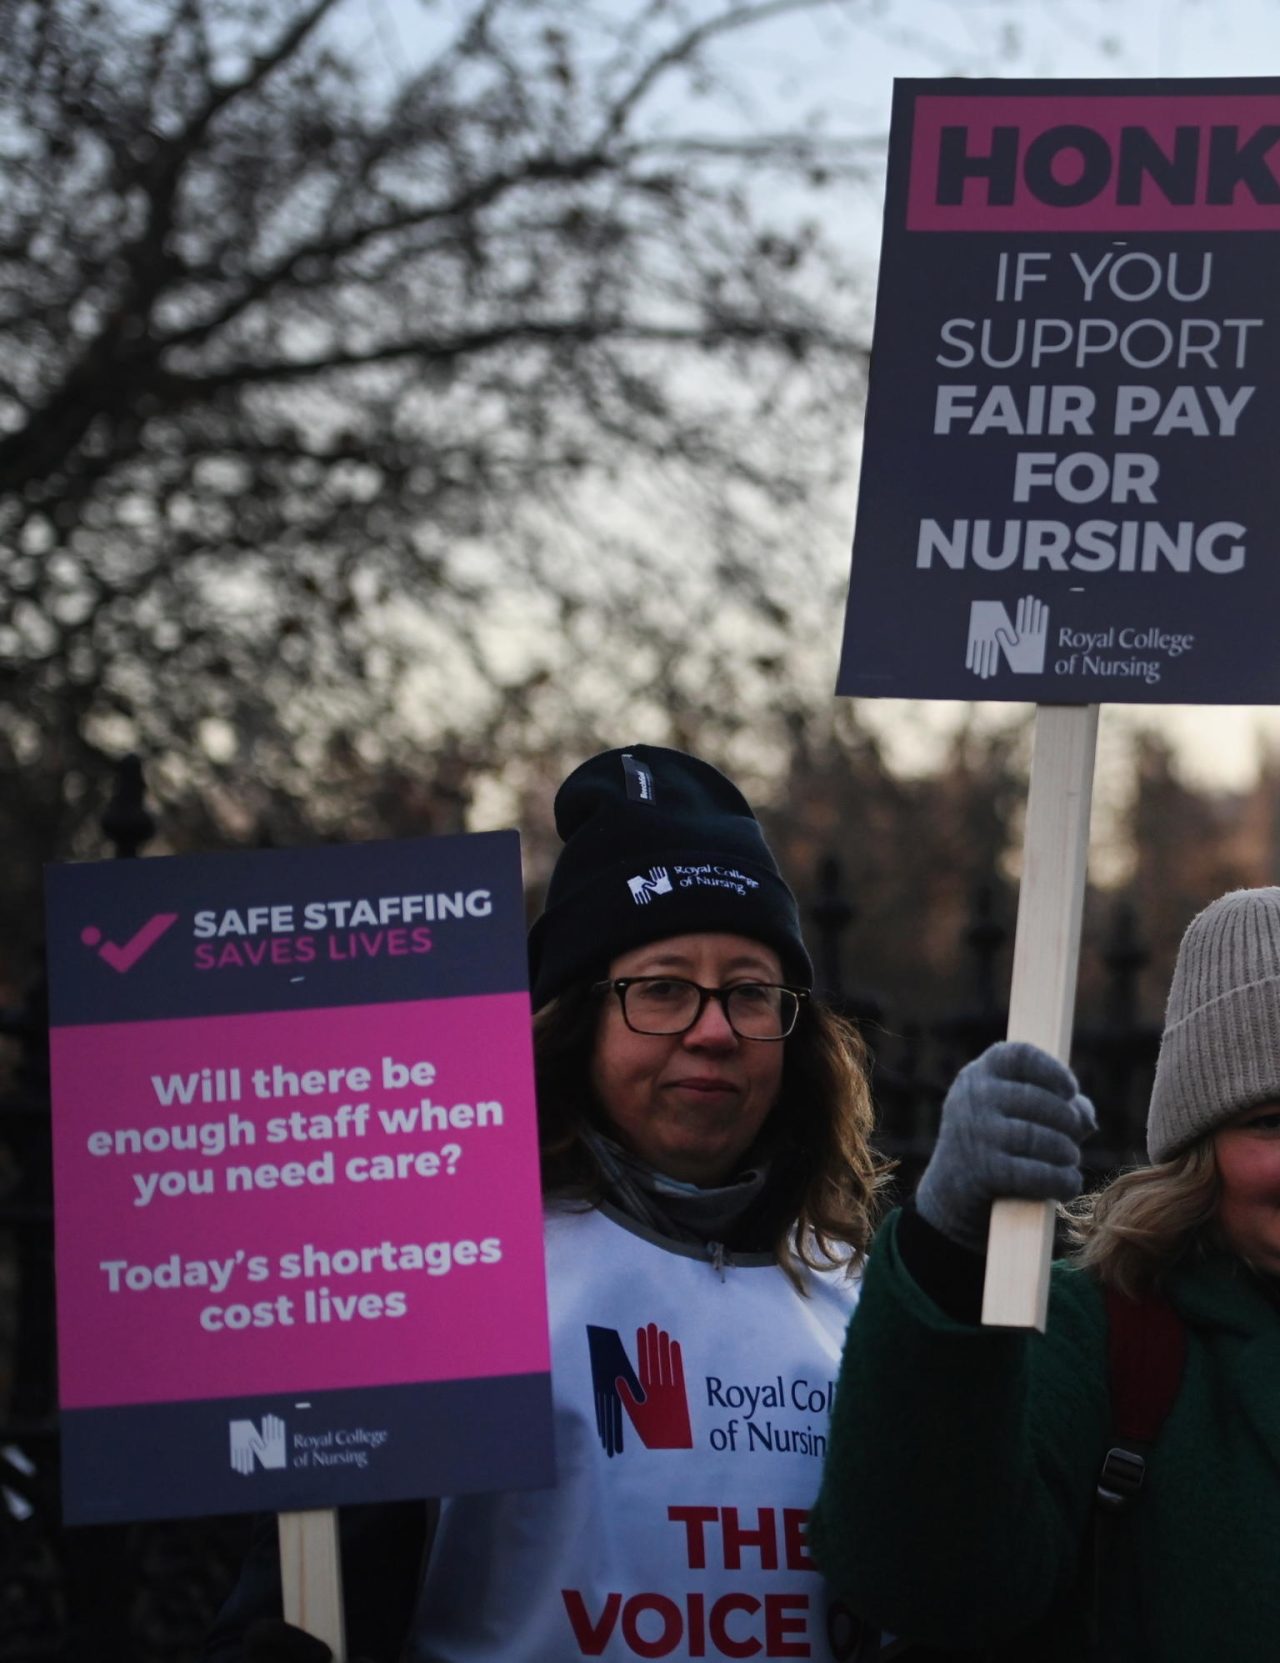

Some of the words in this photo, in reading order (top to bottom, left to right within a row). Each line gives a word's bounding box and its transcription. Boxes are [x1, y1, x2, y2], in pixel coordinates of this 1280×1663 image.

[996, 252, 1051, 302] IF
[1070, 251, 1213, 302] YOU
[935, 318, 1264, 369] SUPPORT
[933, 385, 1097, 436] FAIR
[1113, 385, 1256, 436] PAY
[1013, 452, 1160, 504] FOR
[916, 518, 1248, 574] NURSING
[1058, 627, 1115, 655] Royal
[1118, 628, 1195, 657] College
[1054, 654, 1079, 675] of
[1082, 655, 1161, 684] Nursing
[673, 864, 711, 877] Royal
[679, 876, 693, 887] of
[695, 876, 746, 896] Nursing
[192, 905, 295, 939] SAFE
[303, 889, 492, 931] STAFFING
[194, 935, 316, 971] SAVES
[328, 926, 434, 960] LIVES
[151, 1068, 242, 1107] Will
[251, 1064, 372, 1100] there
[382, 1057, 436, 1089] be
[87, 1113, 255, 1156] enough
[265, 1102, 370, 1143] staff
[378, 1098, 504, 1135] when
[133, 1166, 214, 1208] you
[225, 1151, 334, 1193] need
[344, 1143, 462, 1182] care?
[100, 1250, 270, 1294] Today's
[279, 1237, 502, 1280] shortages
[199, 1295, 295, 1333] cost
[304, 1287, 407, 1325] lives
[705, 1376, 786, 1420] Royal
[791, 1379, 833, 1413] Col
[293, 1451, 309, 1468] of
[312, 1449, 369, 1469] Nursing
[294, 1431, 333, 1449] Royal
[335, 1428, 388, 1449] College
[709, 1420, 739, 1452] of
[748, 1424, 826, 1458] Nursin
[667, 1505, 819, 1572] THE
[560, 1589, 811, 1659] VOICE
